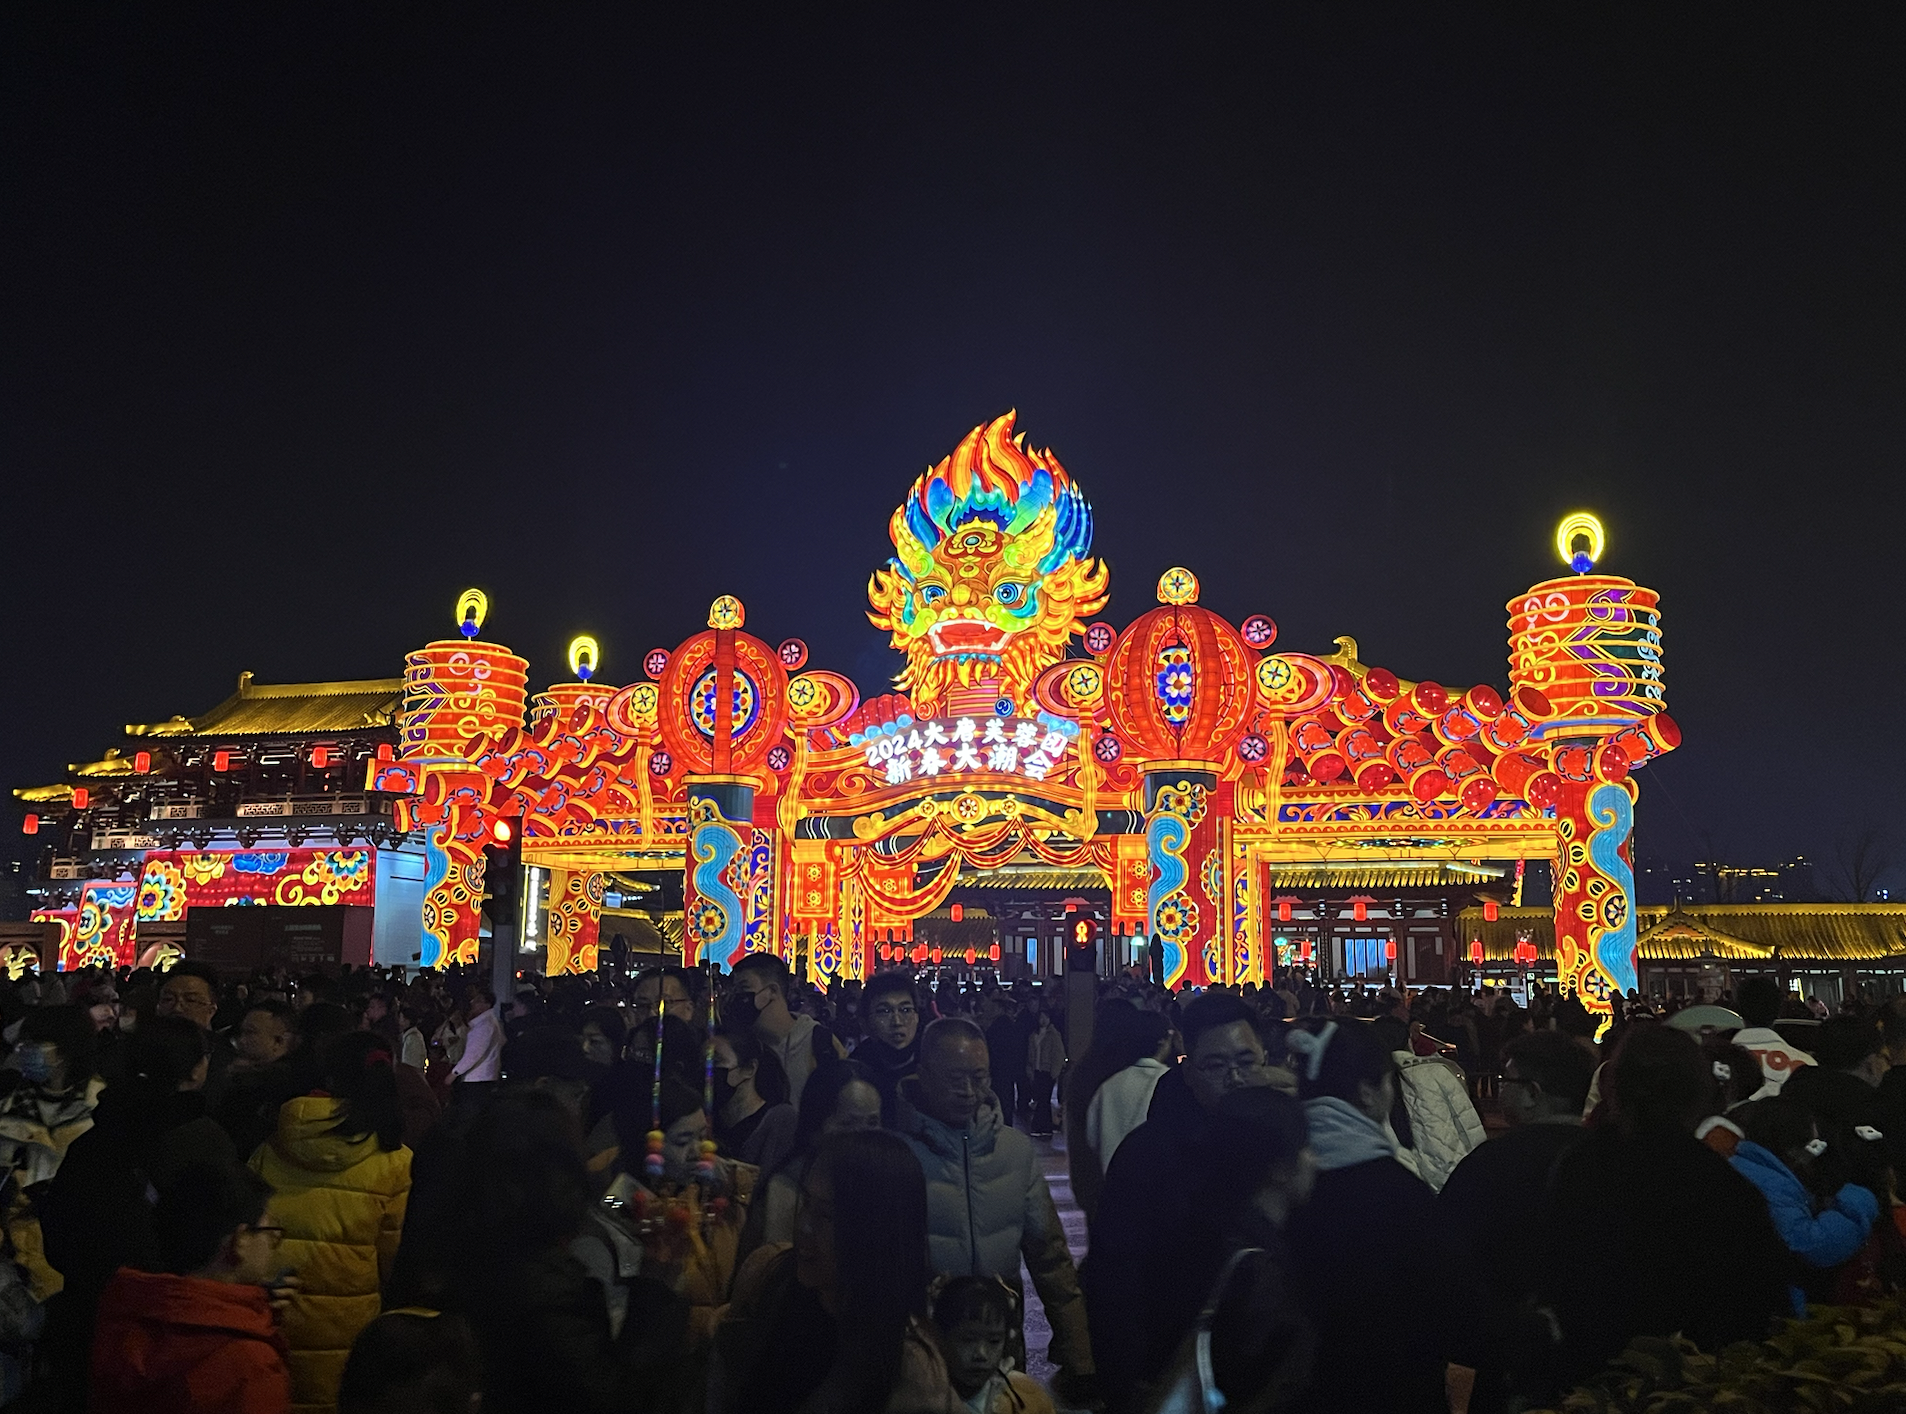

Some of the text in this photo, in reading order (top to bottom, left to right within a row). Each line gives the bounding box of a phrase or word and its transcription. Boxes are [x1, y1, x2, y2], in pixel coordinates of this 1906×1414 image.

[885, 742, 1054, 784] 新春大潮会
